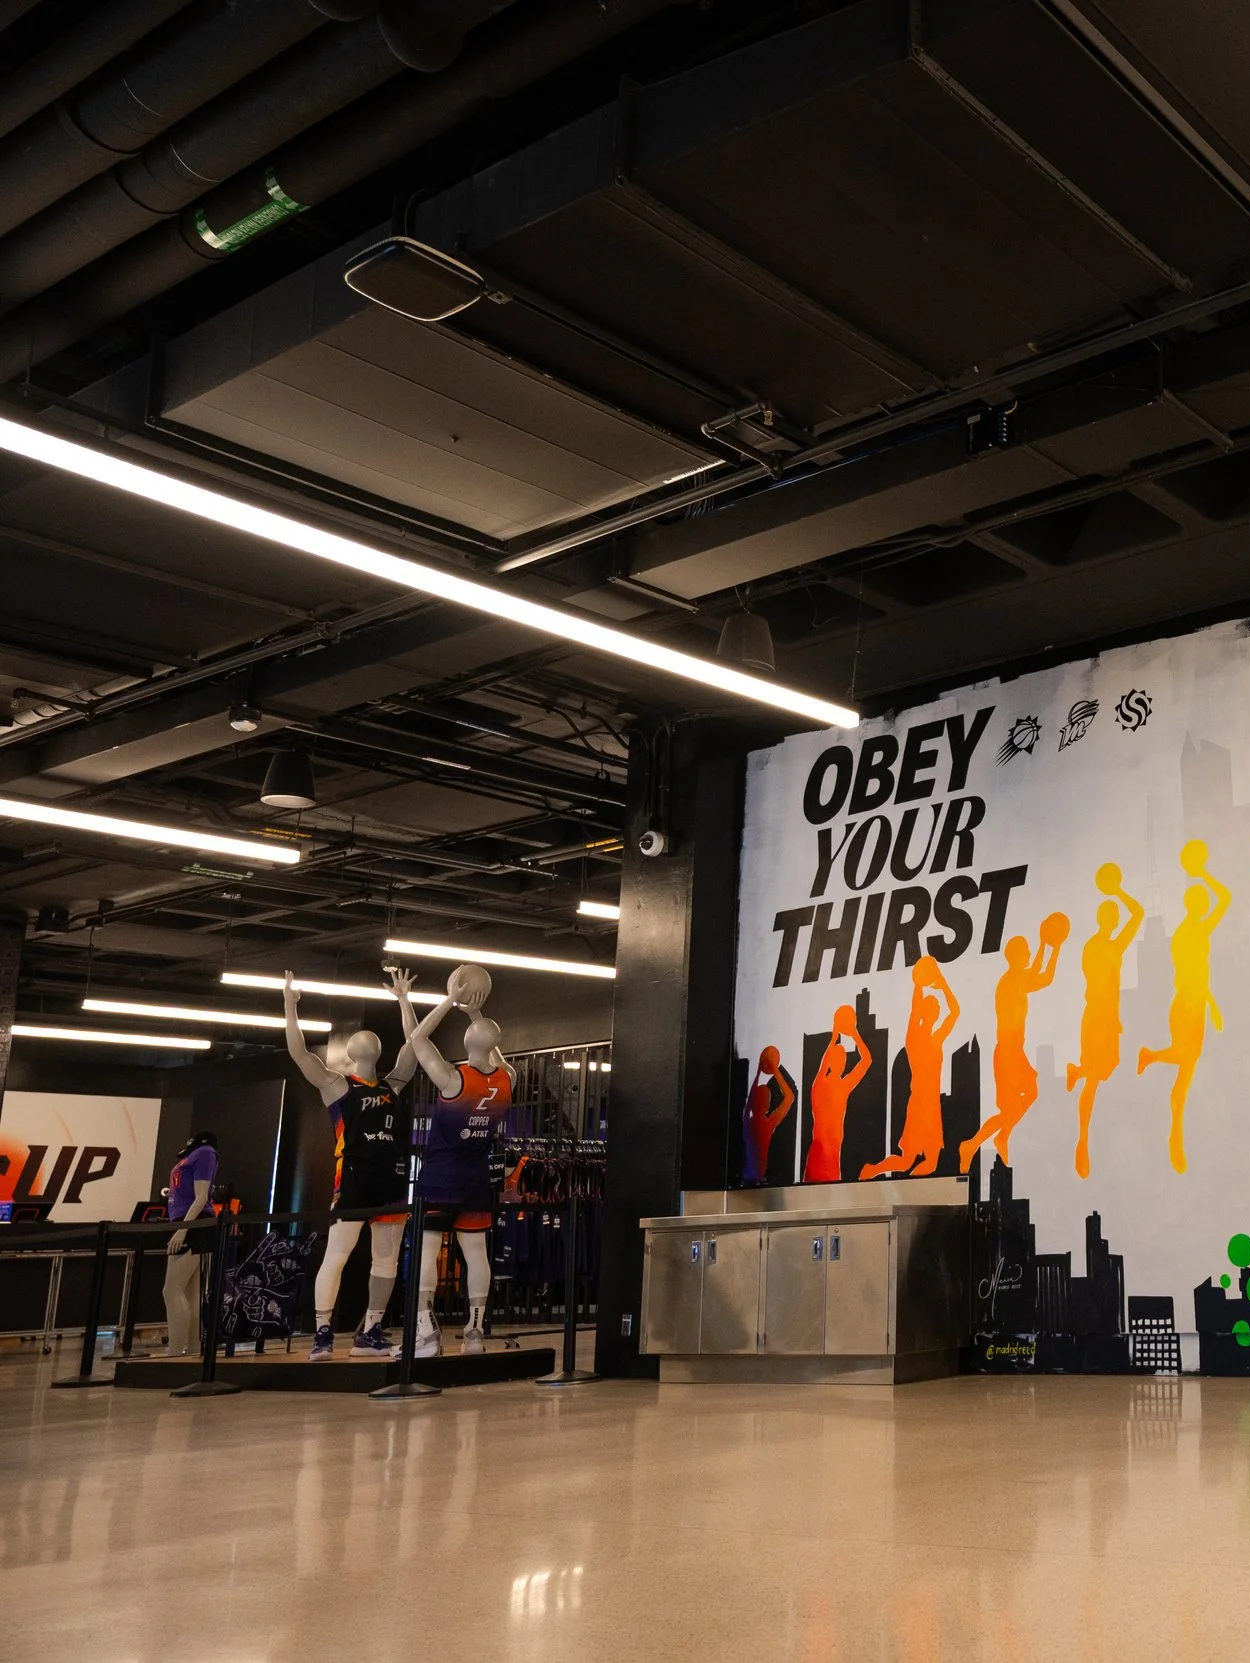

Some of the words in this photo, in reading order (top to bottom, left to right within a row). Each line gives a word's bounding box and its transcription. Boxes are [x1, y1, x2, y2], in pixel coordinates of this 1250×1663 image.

[803, 705, 996, 825] OBEY
[809, 795, 986, 898] YOUR
[772, 864, 1028, 988] THIRST
[361, 1094, 391, 1111] PHX
[476, 1087, 498, 1110] 2
[385, 1114, 393, 1128] 0
[468, 1116, 490, 1126] COPPER
[471, 1130, 489, 1138] AT&T
[12, 1145, 121, 1203] UP
